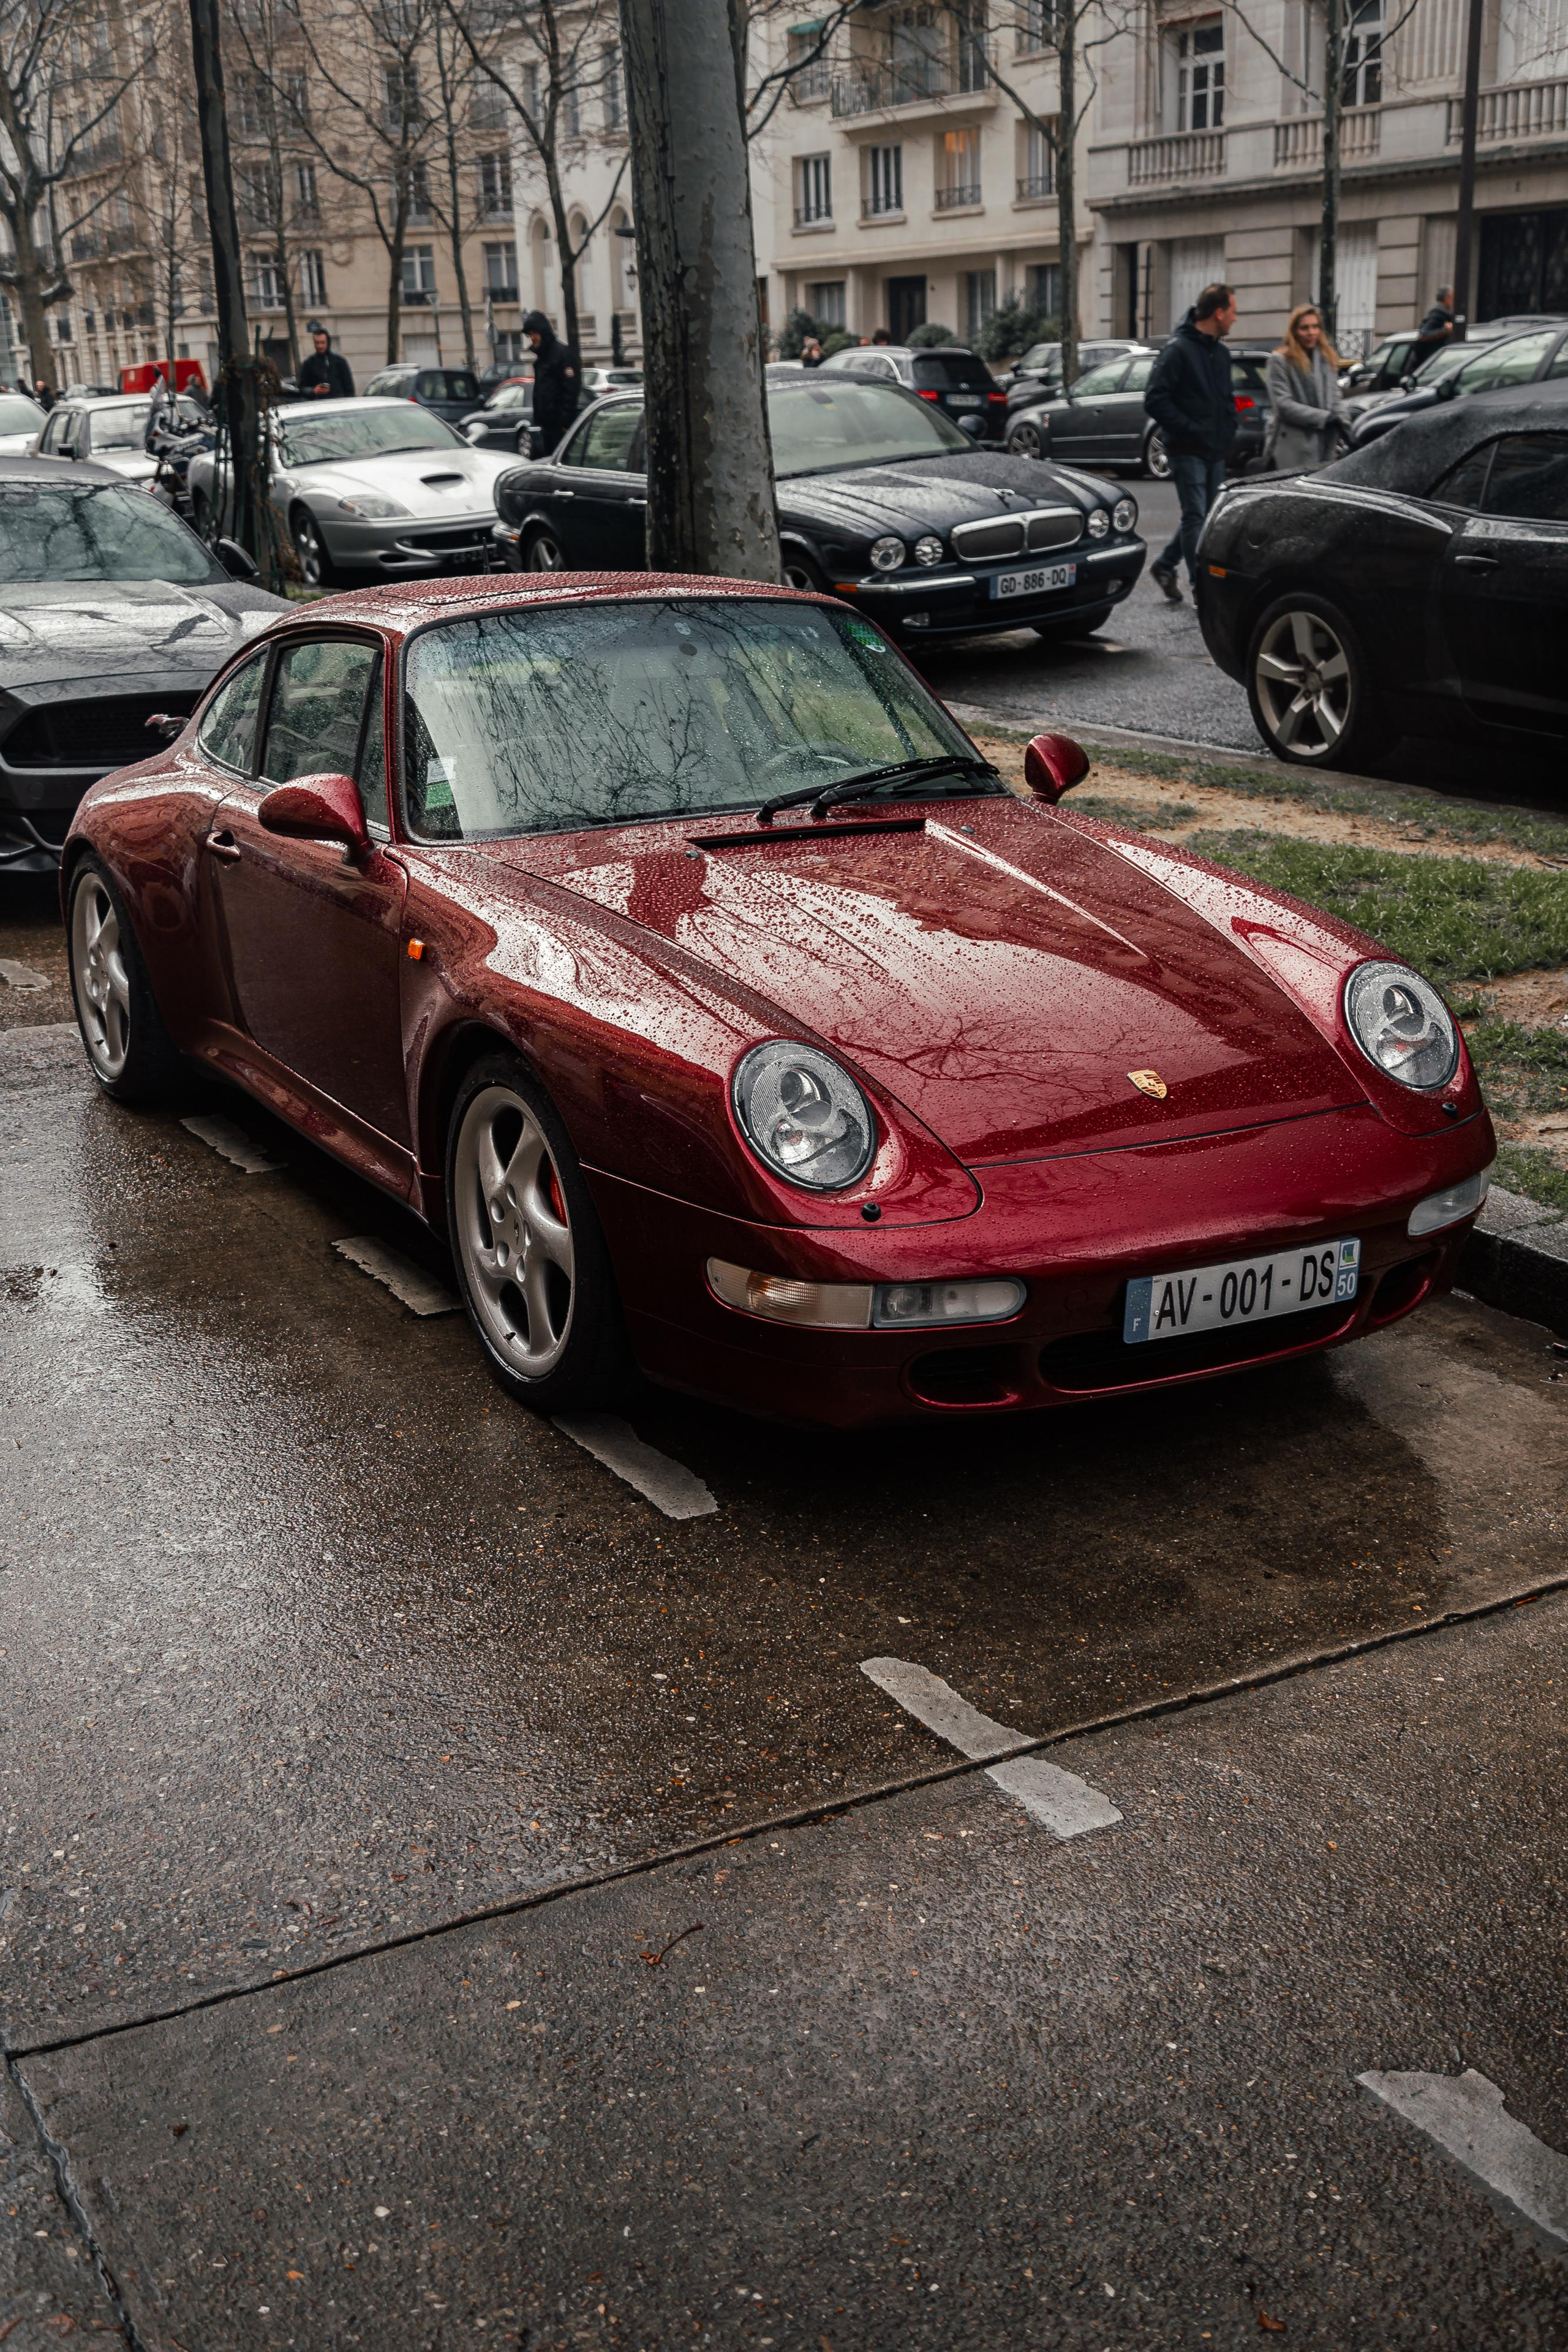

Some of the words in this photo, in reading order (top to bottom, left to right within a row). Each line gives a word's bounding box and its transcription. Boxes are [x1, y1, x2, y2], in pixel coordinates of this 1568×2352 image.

[1001, 568, 1066, 594] GD-886-DQ
[1337, 1272, 1355, 1296] 50
[1133, 1317, 1142, 1332] F
